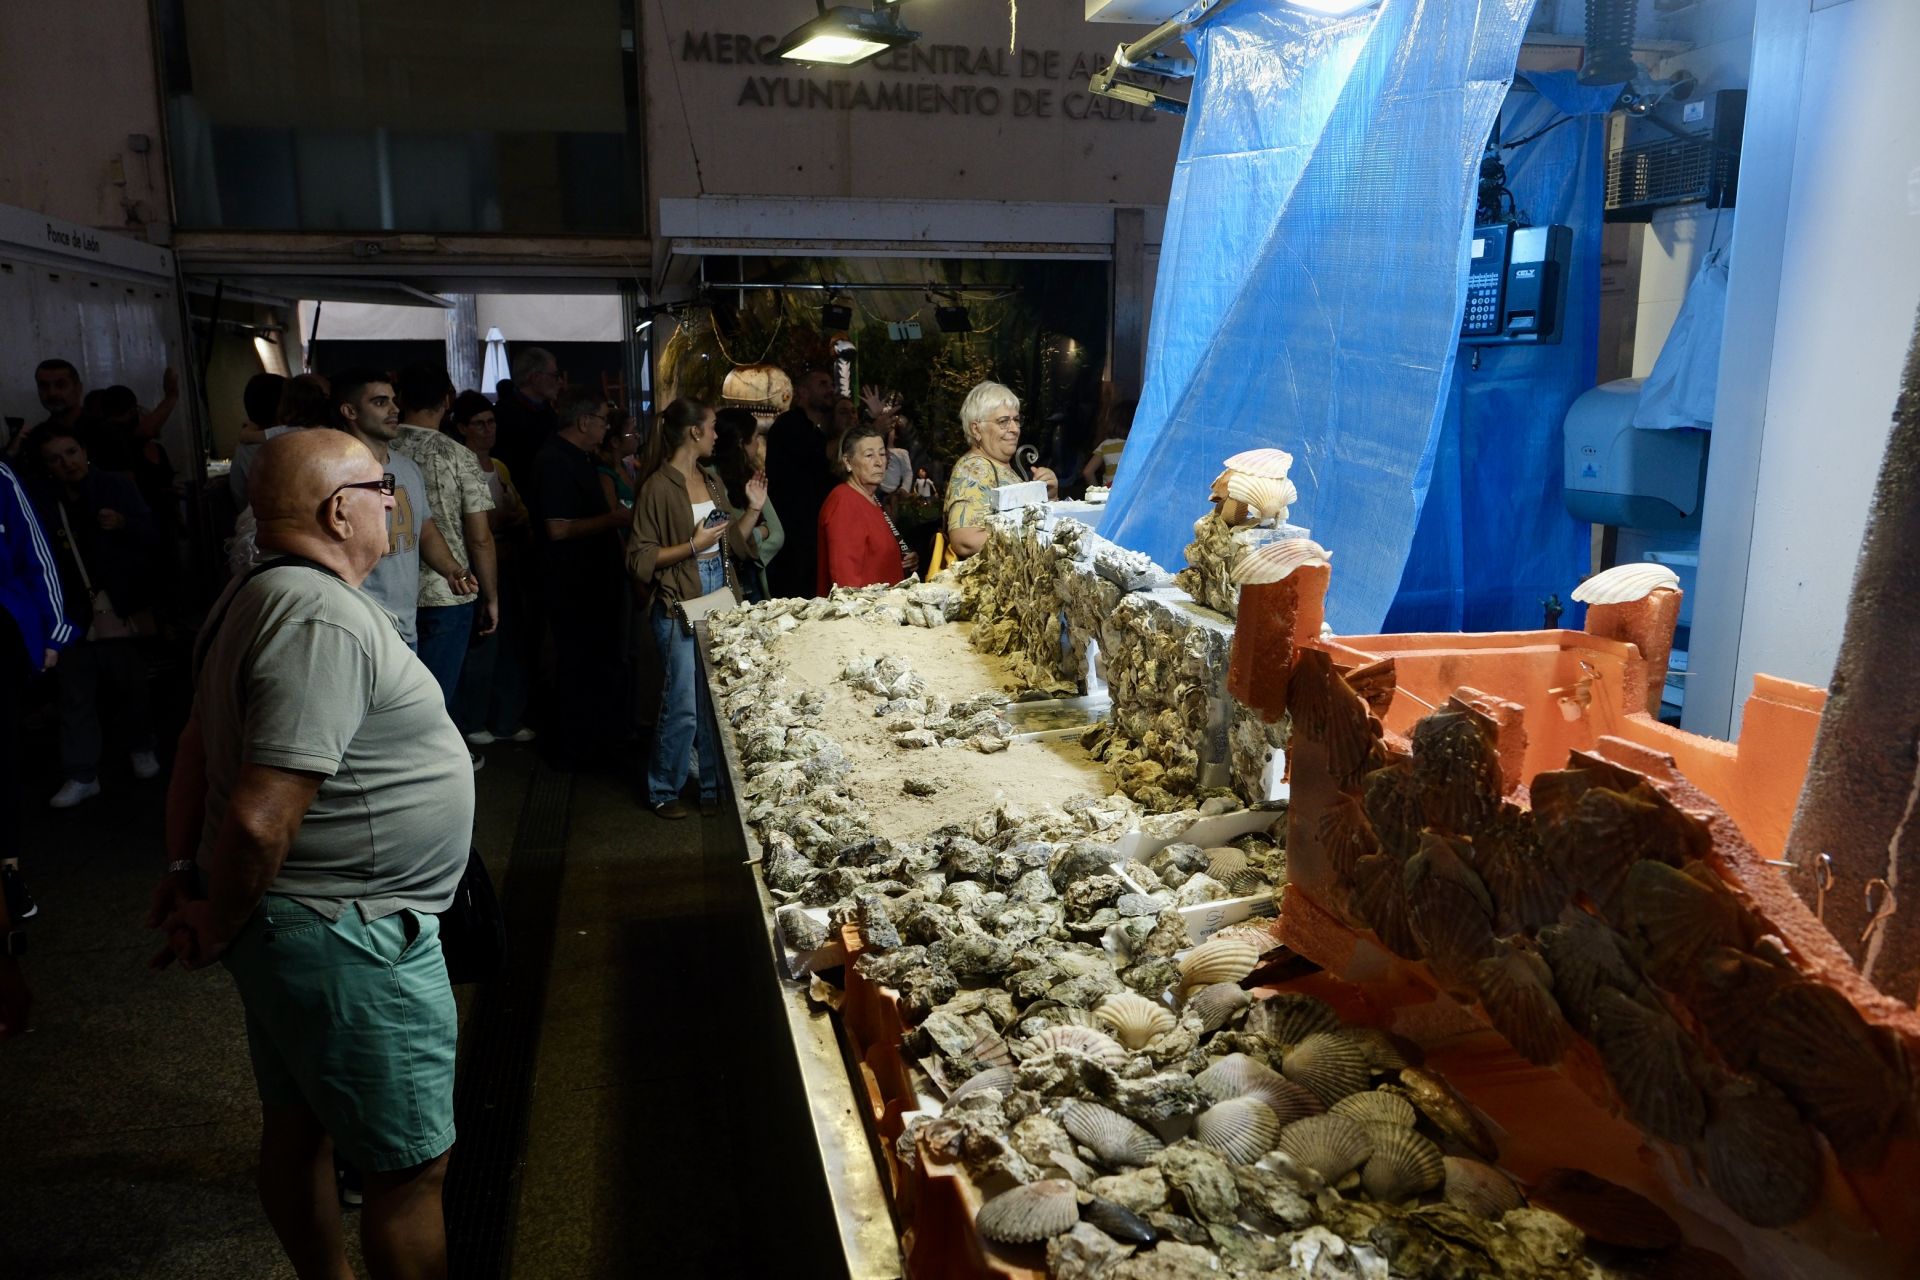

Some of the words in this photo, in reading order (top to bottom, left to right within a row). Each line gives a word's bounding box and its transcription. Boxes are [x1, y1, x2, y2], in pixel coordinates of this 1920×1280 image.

[682, 29, 783, 66] MERC
[1020, 50, 1060, 80] DE
[737, 76, 1000, 116] AYUNTAMIENTO
[1013, 88, 1053, 118] DE
[47, 223, 70, 246] Ponce
[72, 229, 81, 249] de
